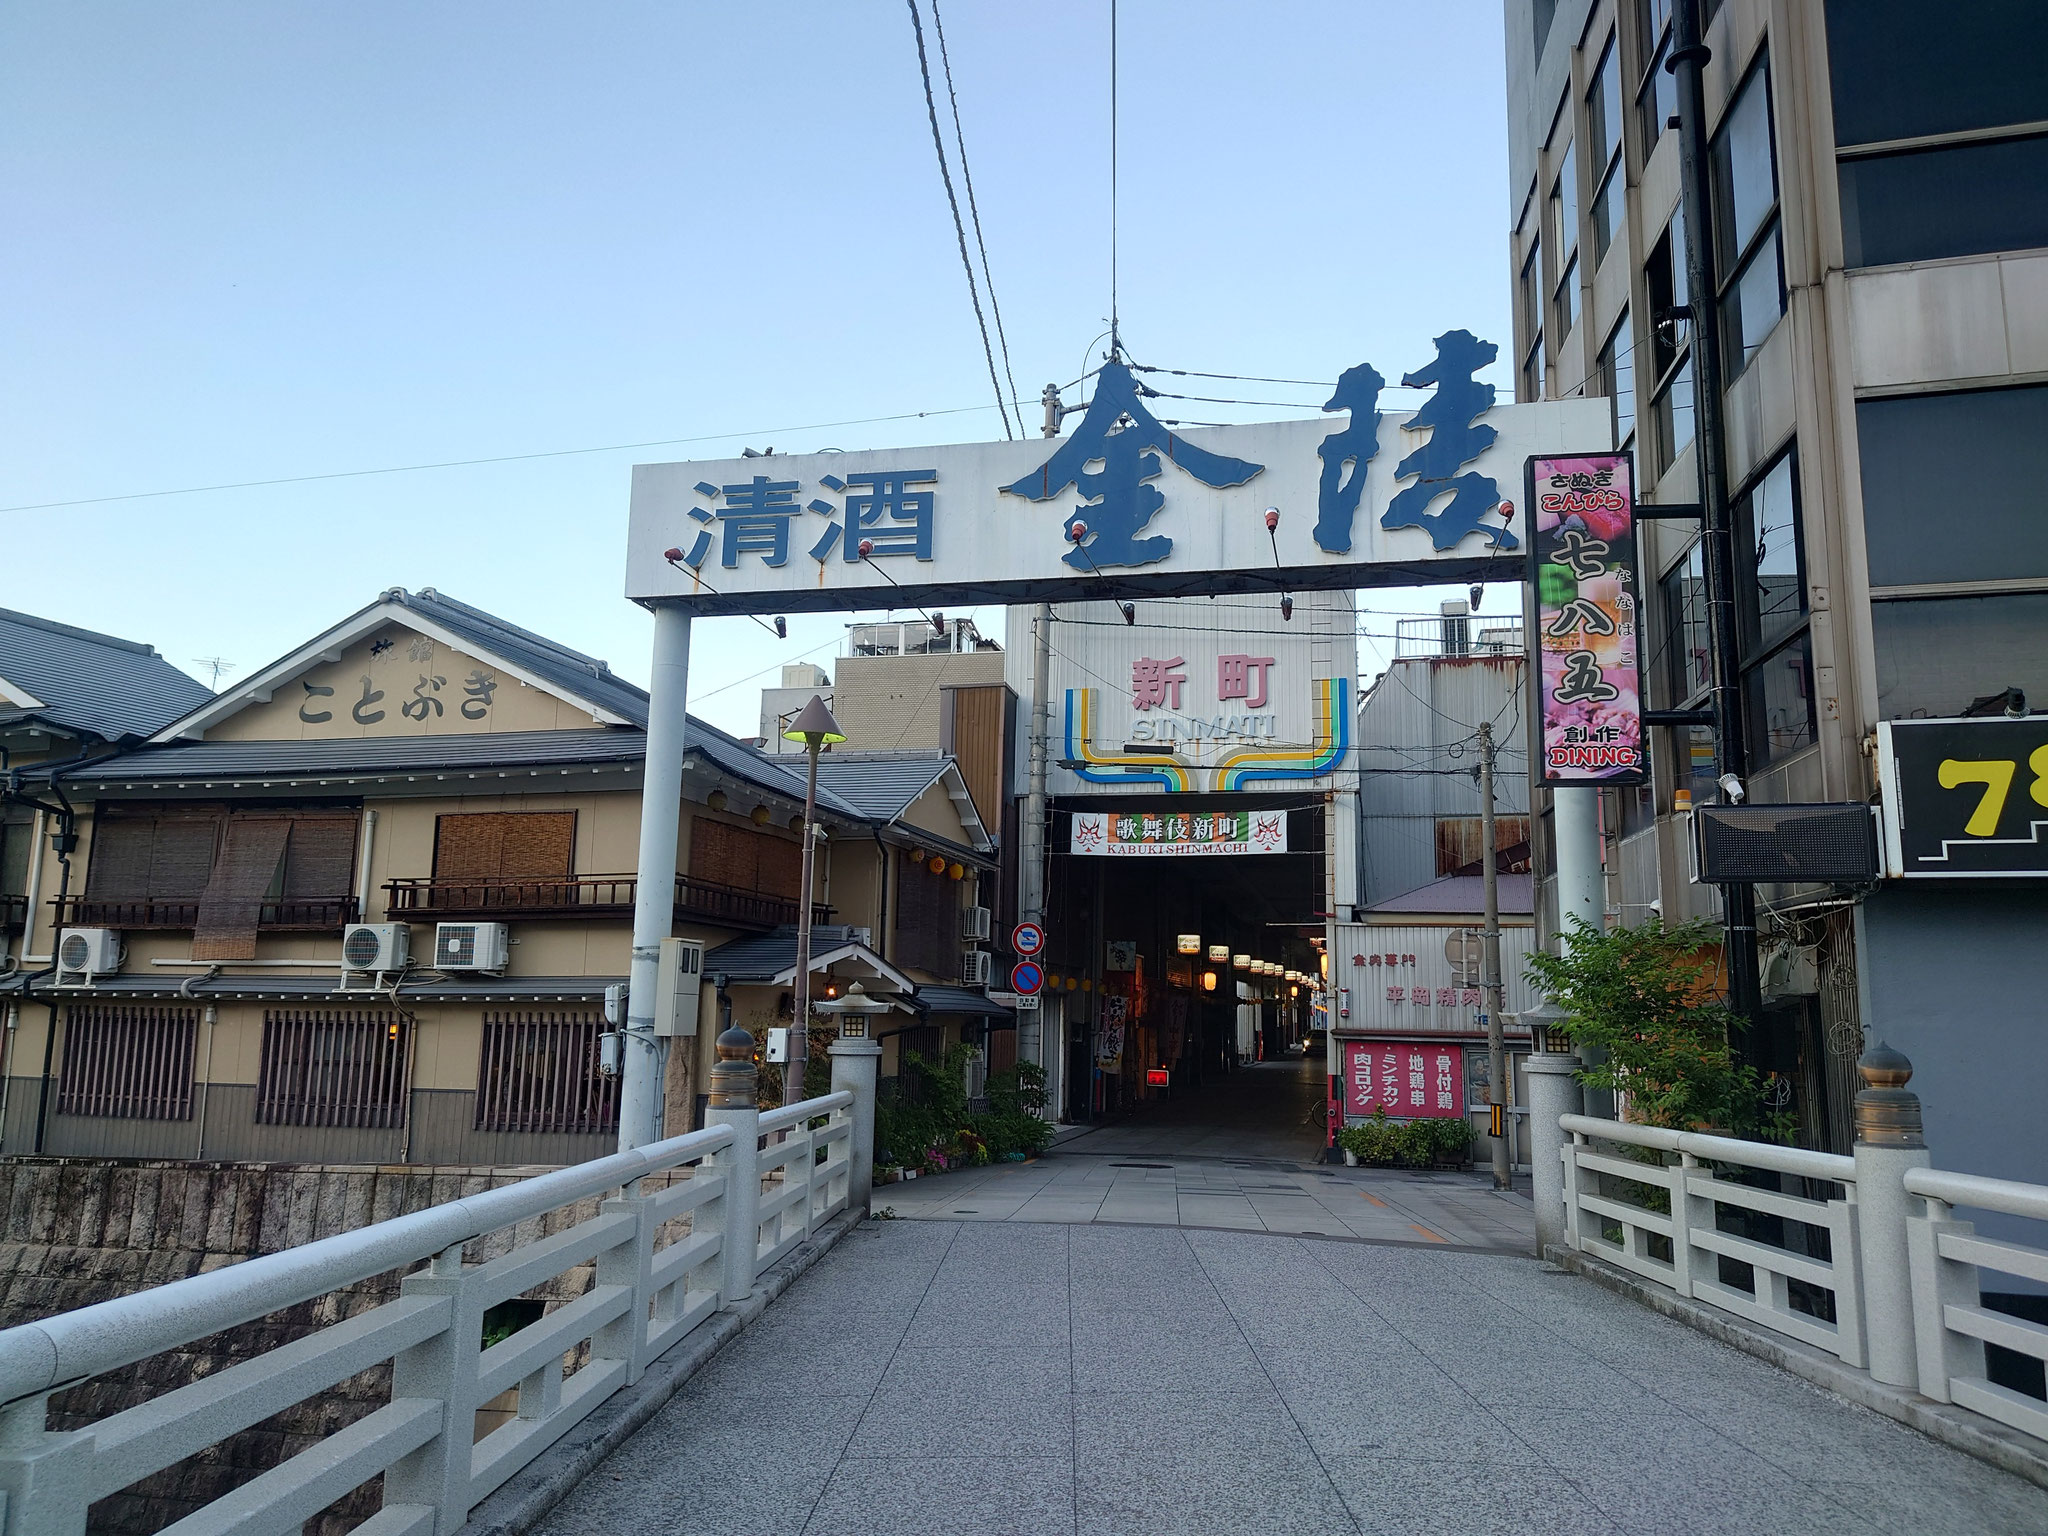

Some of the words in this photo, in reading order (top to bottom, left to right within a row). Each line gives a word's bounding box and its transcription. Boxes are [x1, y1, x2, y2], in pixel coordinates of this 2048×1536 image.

[1541, 492, 1624, 512] こんぴら
[1549, 471, 1613, 488] さぬき
[684, 469, 937, 568] 清酒
[1549, 530, 1619, 706] 七八五
[1615, 567, 1634, 665] ななはこ
[298, 670, 498, 726] ことぶき
[1132, 654, 1275, 711] 新町
[1131, 714, 1276, 742] SINMATI
[1563, 726, 1620, 744] 創作
[1549, 747, 1636, 767] DINING
[1937, 743, 2048, 837] 7
[1115, 817, 1241, 841] 歌舞伎新町
[1386, 986, 1507, 1008] 平岡精肉
[1354, 1052, 1373, 1106] 肉コロッケ
[1382, 1052, 1399, 1107] ミンチカツ
[1409, 1054, 1425, 1107] 地鶏串
[1436, 1055, 1453, 1110] 骨付鶏
